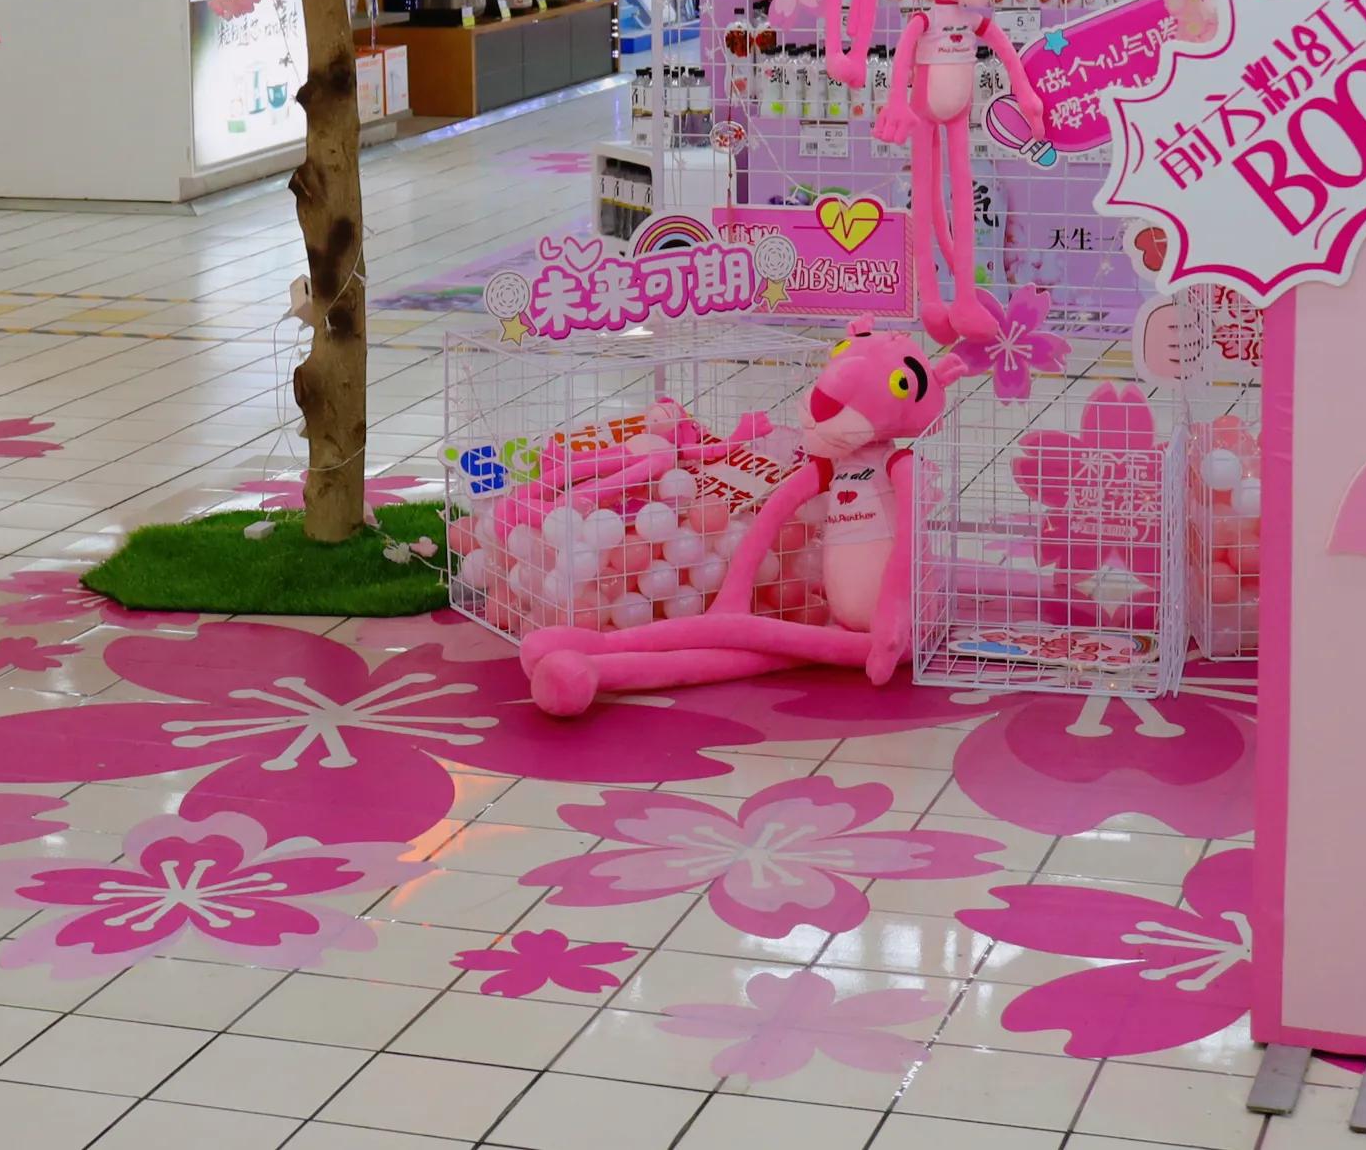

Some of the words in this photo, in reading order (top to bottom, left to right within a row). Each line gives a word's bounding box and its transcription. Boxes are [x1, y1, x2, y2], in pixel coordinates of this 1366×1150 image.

[1048, 227, 1124, 250] 天生一
[533, 249, 753, 334] 未来可期
[785, 258, 899, 294] 动的感觉
